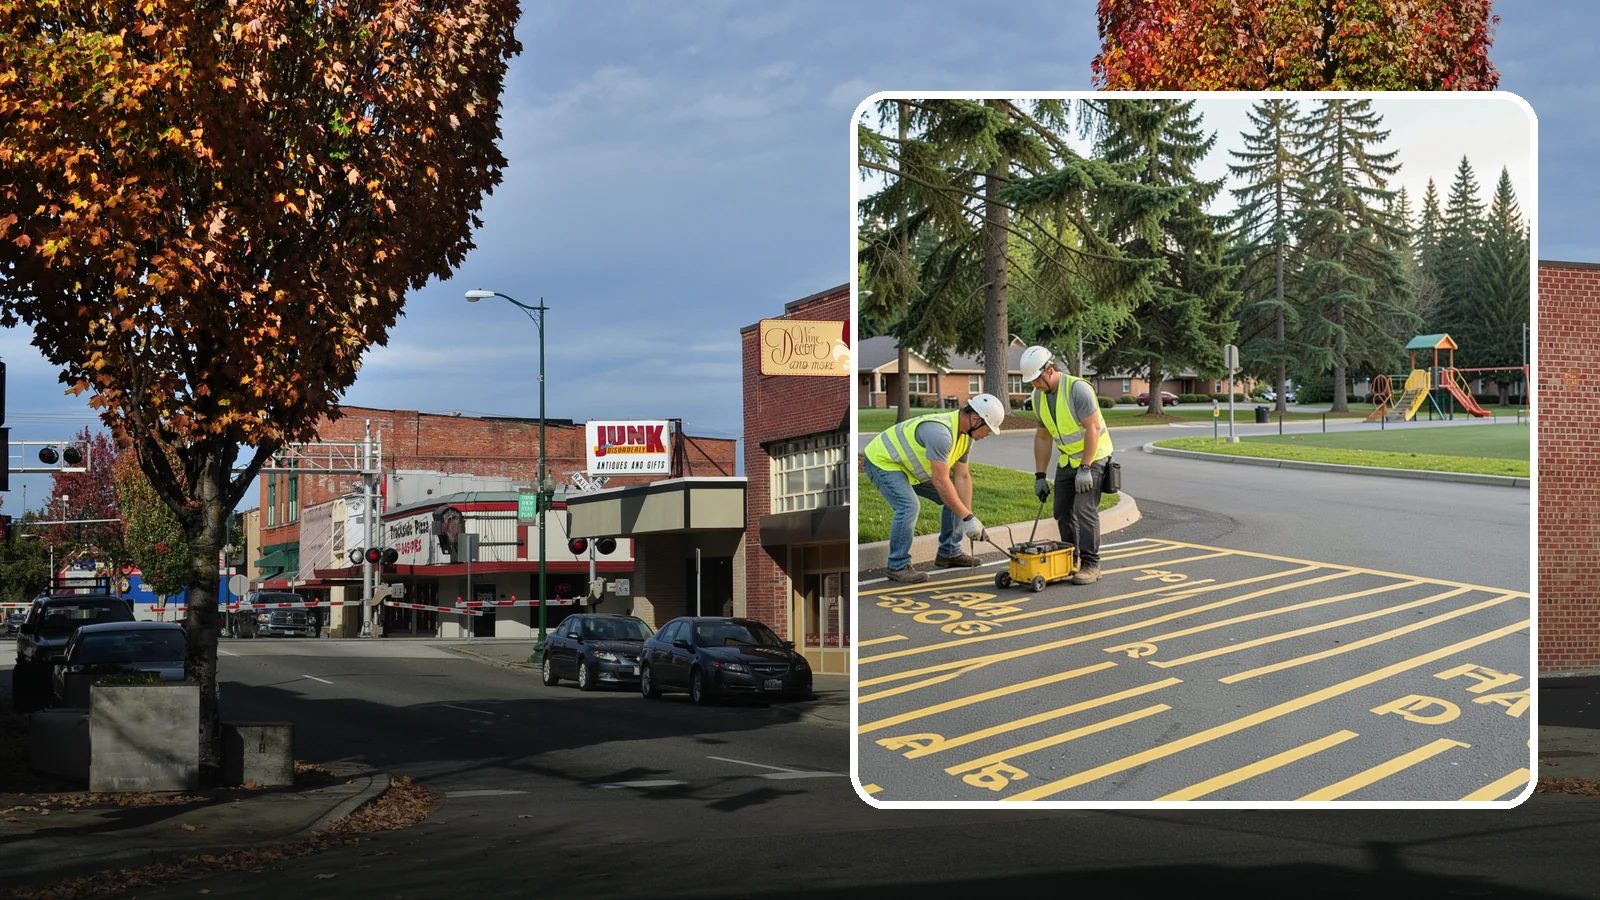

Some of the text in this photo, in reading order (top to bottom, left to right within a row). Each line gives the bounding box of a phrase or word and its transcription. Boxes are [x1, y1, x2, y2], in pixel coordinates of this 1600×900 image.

[765, 328, 831, 365] Decor
[595, 425, 665, 457] JUNK
[607, 446, 646, 454] DISORDERLY
[596, 461, 665, 470] ANTIQUES AND GIFTS
[415, 520, 429, 534] Pizza
